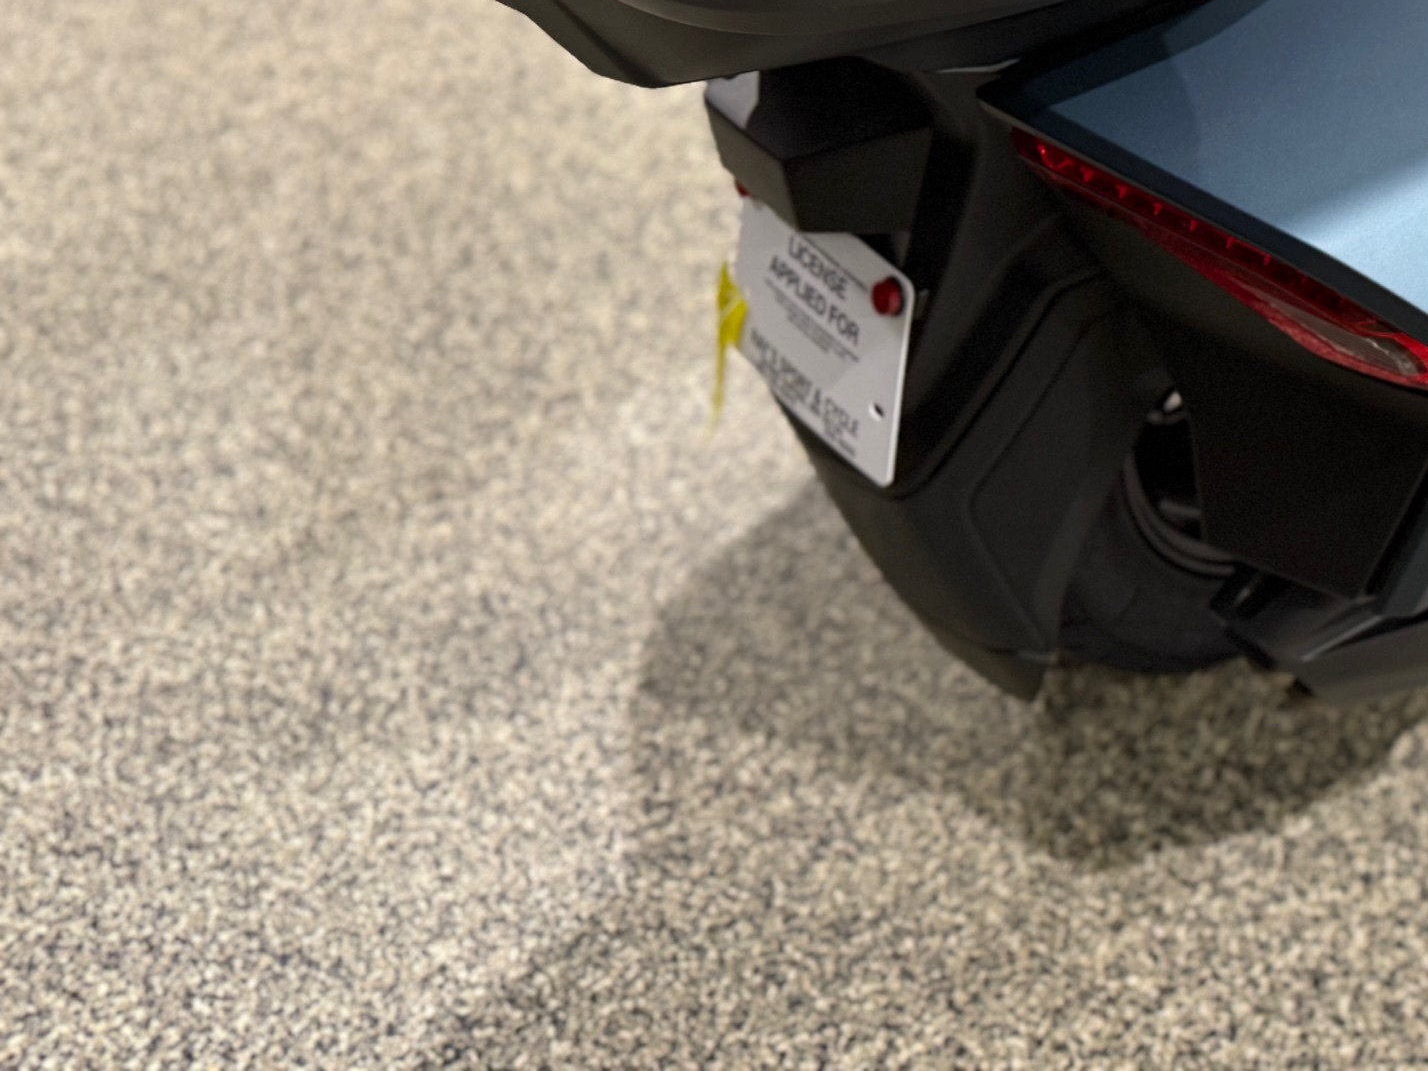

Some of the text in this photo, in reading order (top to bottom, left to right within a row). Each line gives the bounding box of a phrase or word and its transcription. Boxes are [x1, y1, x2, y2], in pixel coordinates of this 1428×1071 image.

[769, 254, 827, 317] APPLIED
[827, 302, 861, 346] FOR
[787, 233, 848, 302] LICENSE
